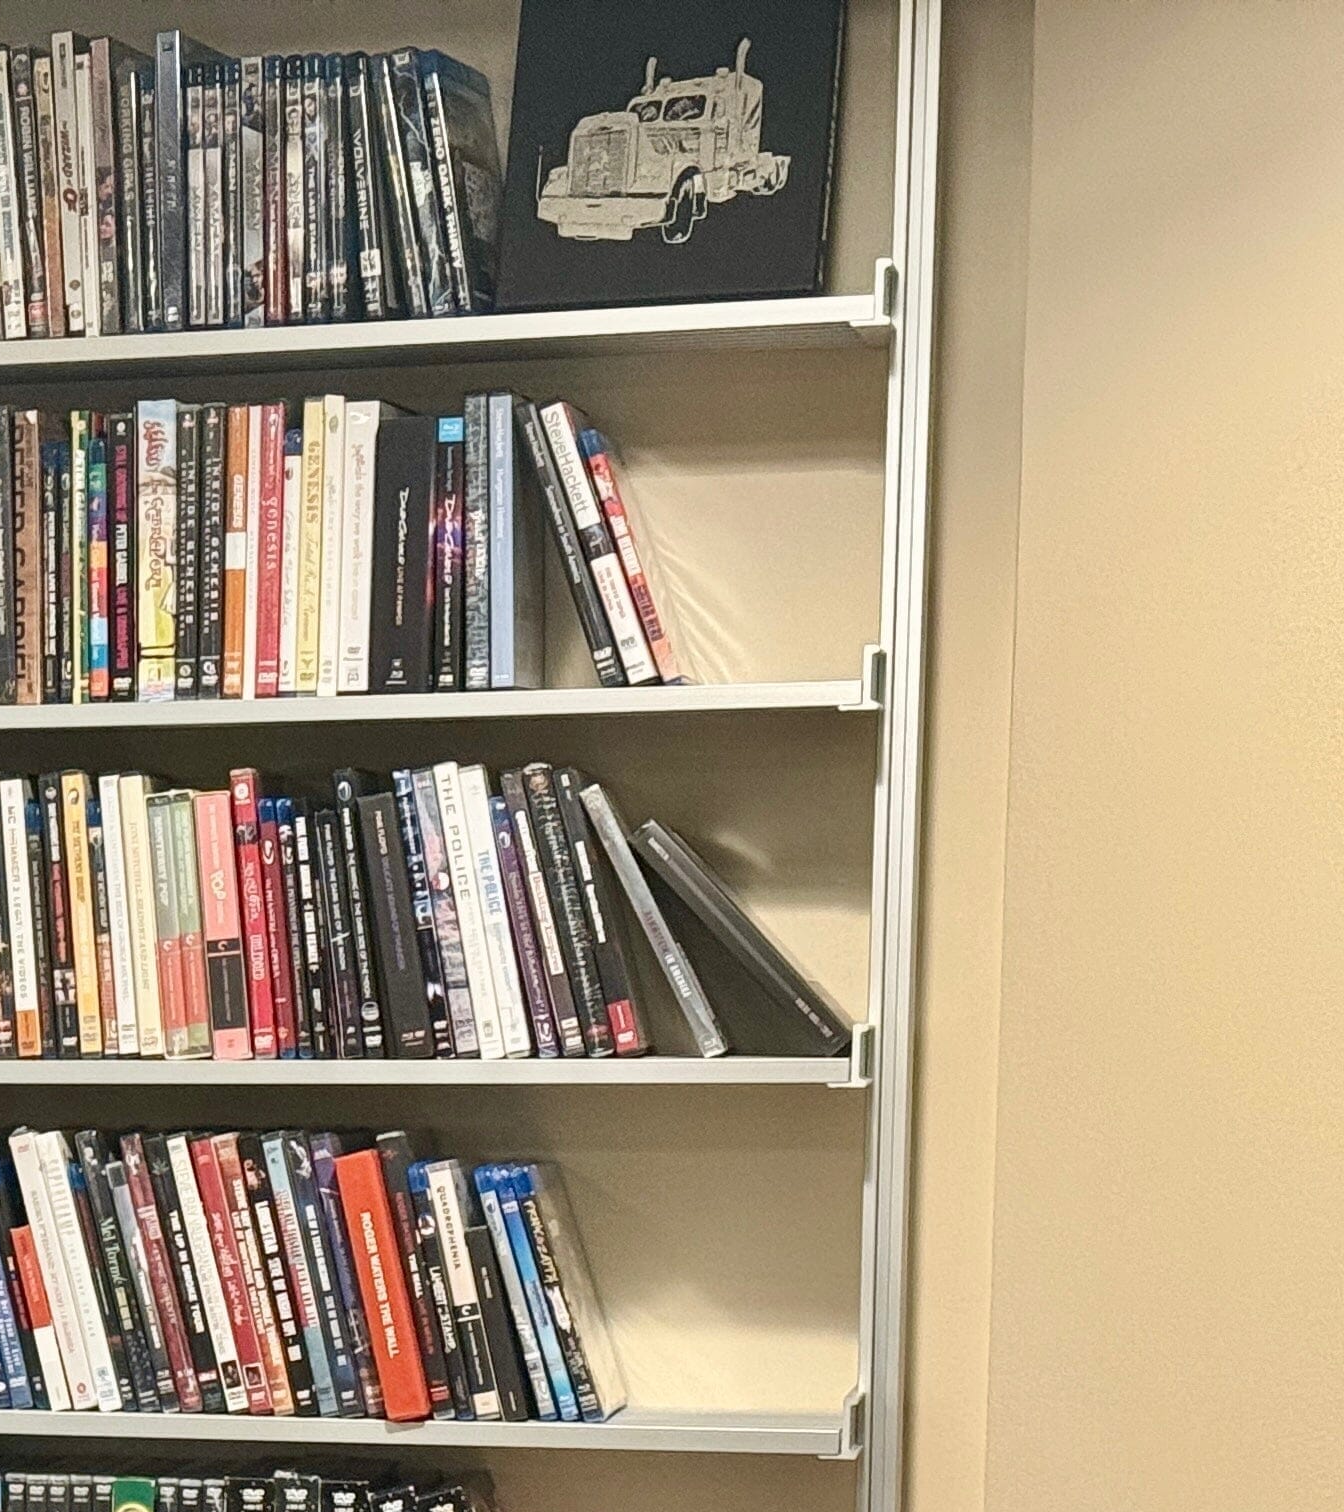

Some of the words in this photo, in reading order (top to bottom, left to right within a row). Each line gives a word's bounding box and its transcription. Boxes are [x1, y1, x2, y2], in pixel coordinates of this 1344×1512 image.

[430, 117, 445, 160] ZERO
[353, 128, 369, 231] WOLVERINE
[437, 163, 453, 208] DARK
[444, 209, 462, 268] THIRTY
[233, 474, 243, 528] GENESIS
[305, 441, 320, 524] GENESIS
[440, 774, 456, 814] THE
[445, 825, 471, 899] POLICE
[478, 851, 494, 873] THE
[482, 875, 502, 915] POLICE
[360, 1212, 378, 1253] ROGER
[436, 1185, 461, 1270] QUADROPHENIA
[369, 1255, 388, 1301] WATERS
[379, 1303, 391, 1325] THE
[384, 1326, 399, 1358] WALL
